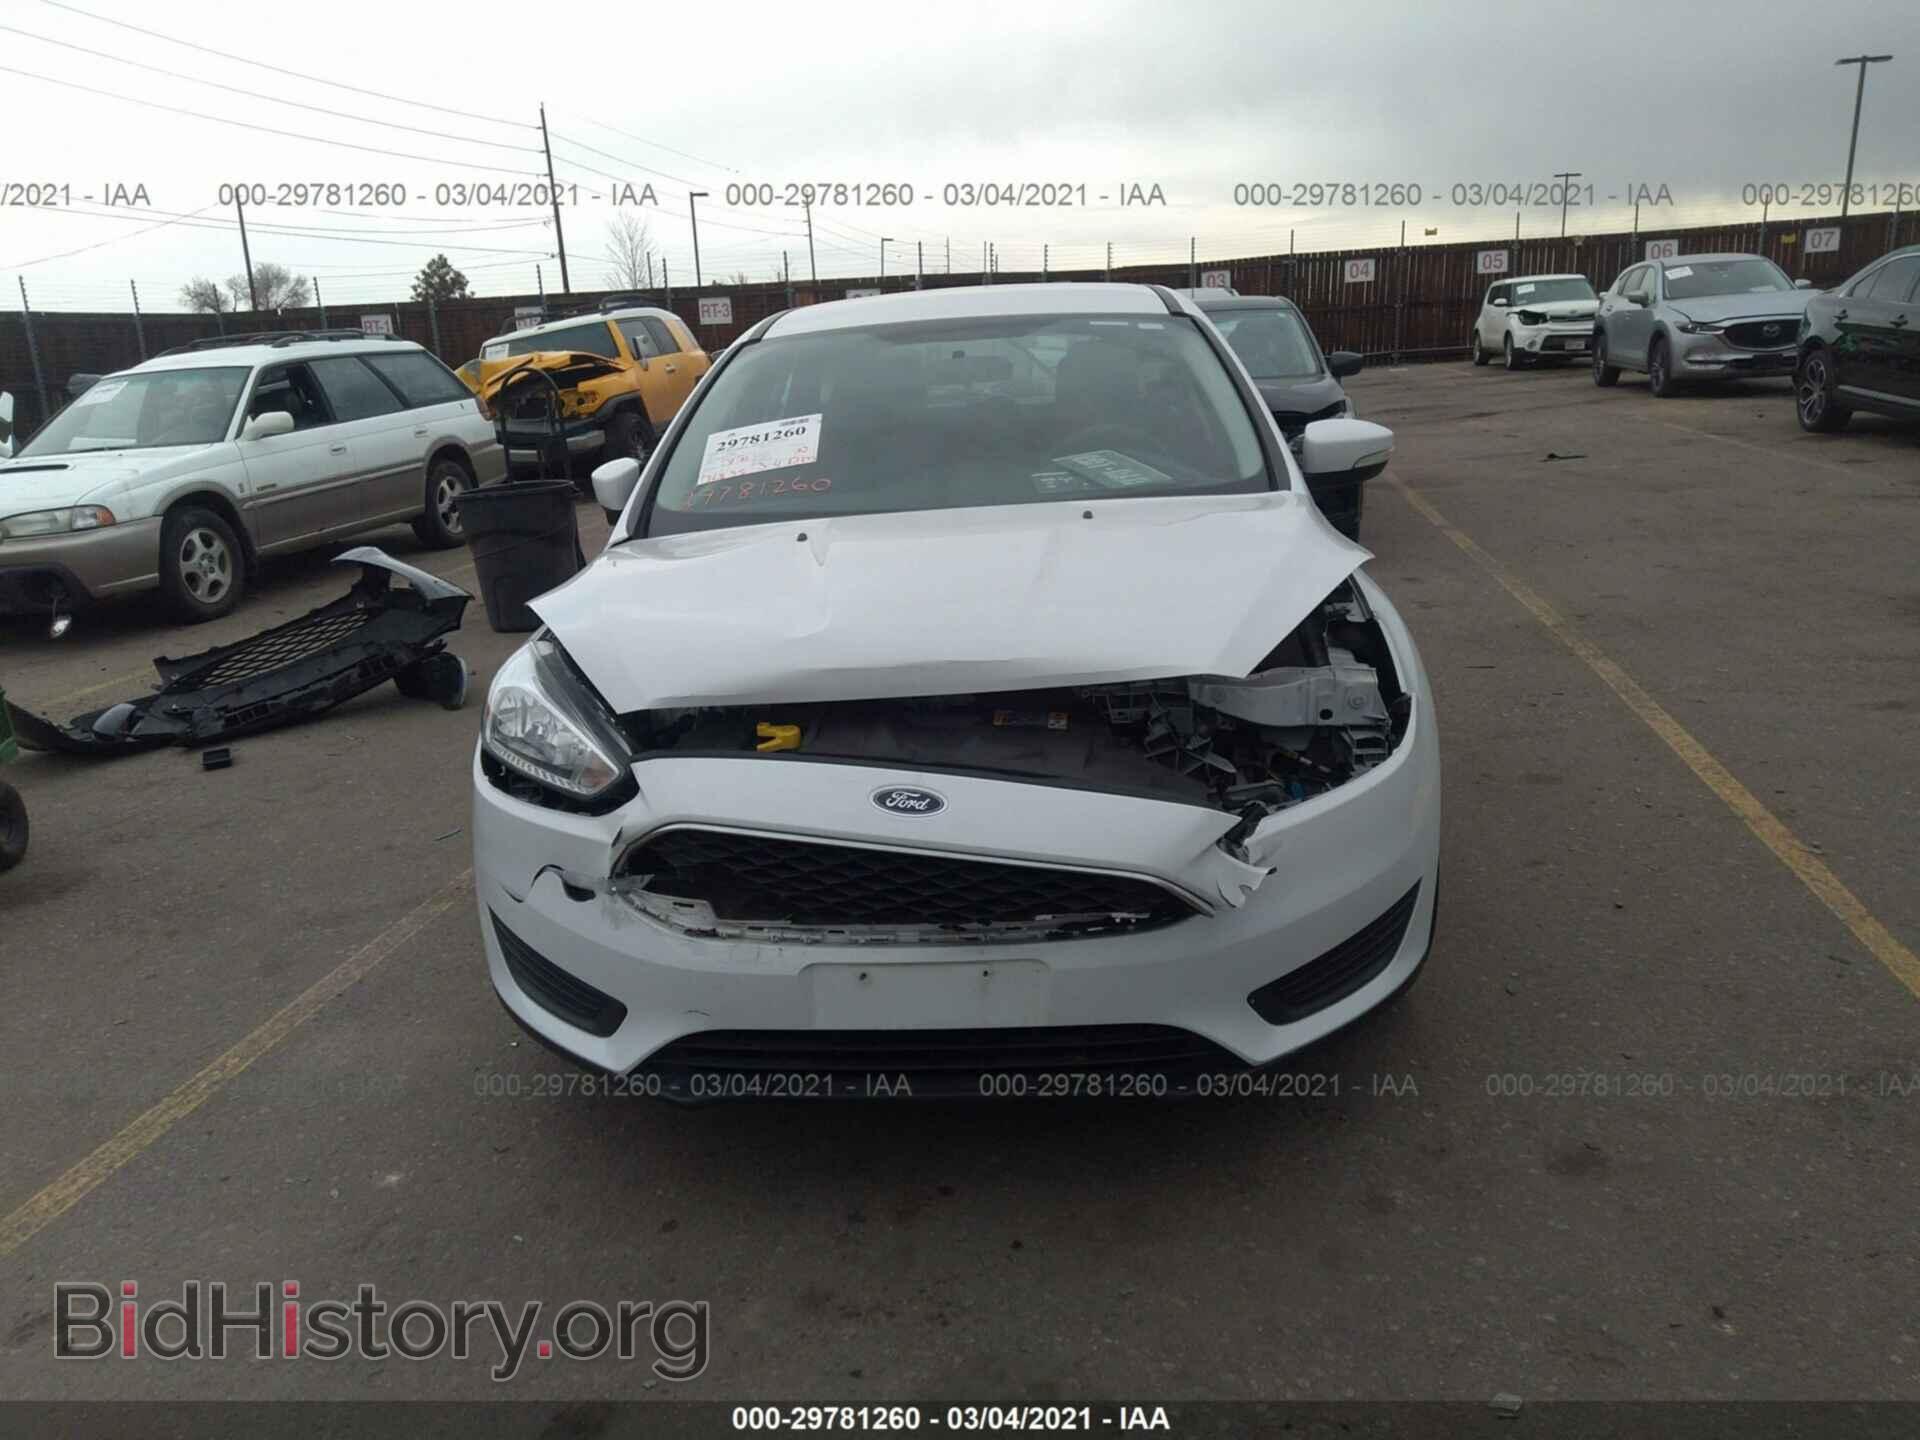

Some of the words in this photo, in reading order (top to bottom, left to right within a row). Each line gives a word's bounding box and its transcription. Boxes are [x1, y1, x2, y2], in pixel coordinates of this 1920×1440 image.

[1811, 231, 1835, 248] 07
[1651, 243, 1673, 259] 06
[1349, 261, 1370, 279] 04
[1483, 253, 1504, 270] 05
[701, 303, 729, 318] RT-3
[363, 319, 390, 335] RT-1
[716, 426, 807, 452] 29781260
[886, 790, 931, 811] Ford
